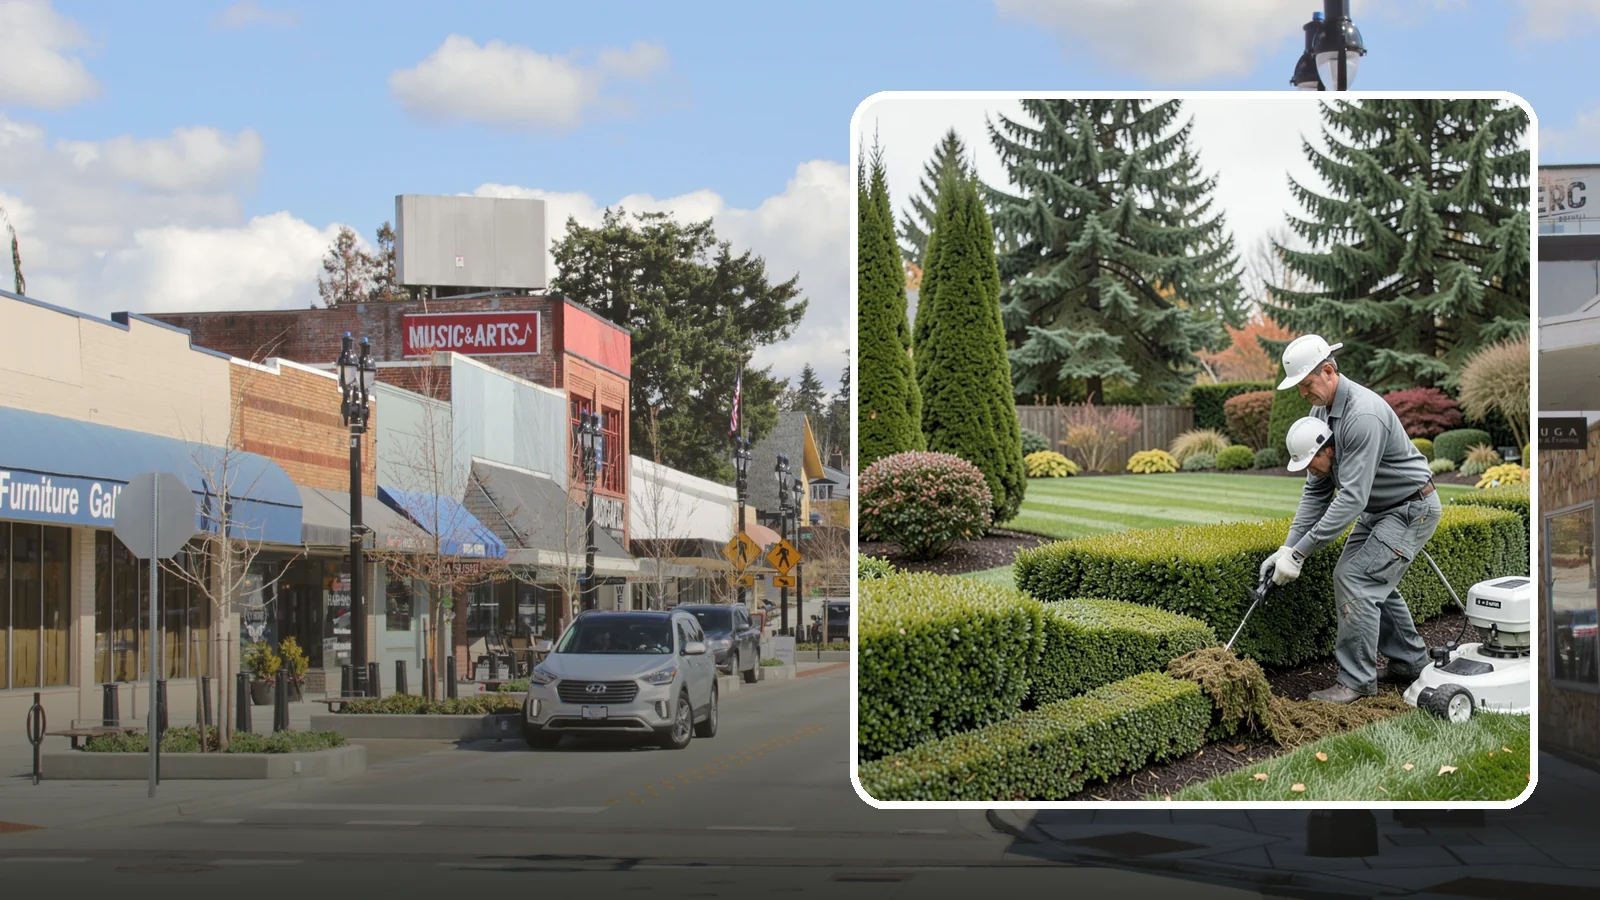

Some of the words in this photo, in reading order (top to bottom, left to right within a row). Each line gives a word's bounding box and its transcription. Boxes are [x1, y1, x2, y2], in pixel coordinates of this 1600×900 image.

[409, 323, 519, 348] MUSIC&ARTS
[0, 471, 79, 515] Furniture
[89, 482, 122, 519] Gal
[453, 563, 479, 574] SUSHI
